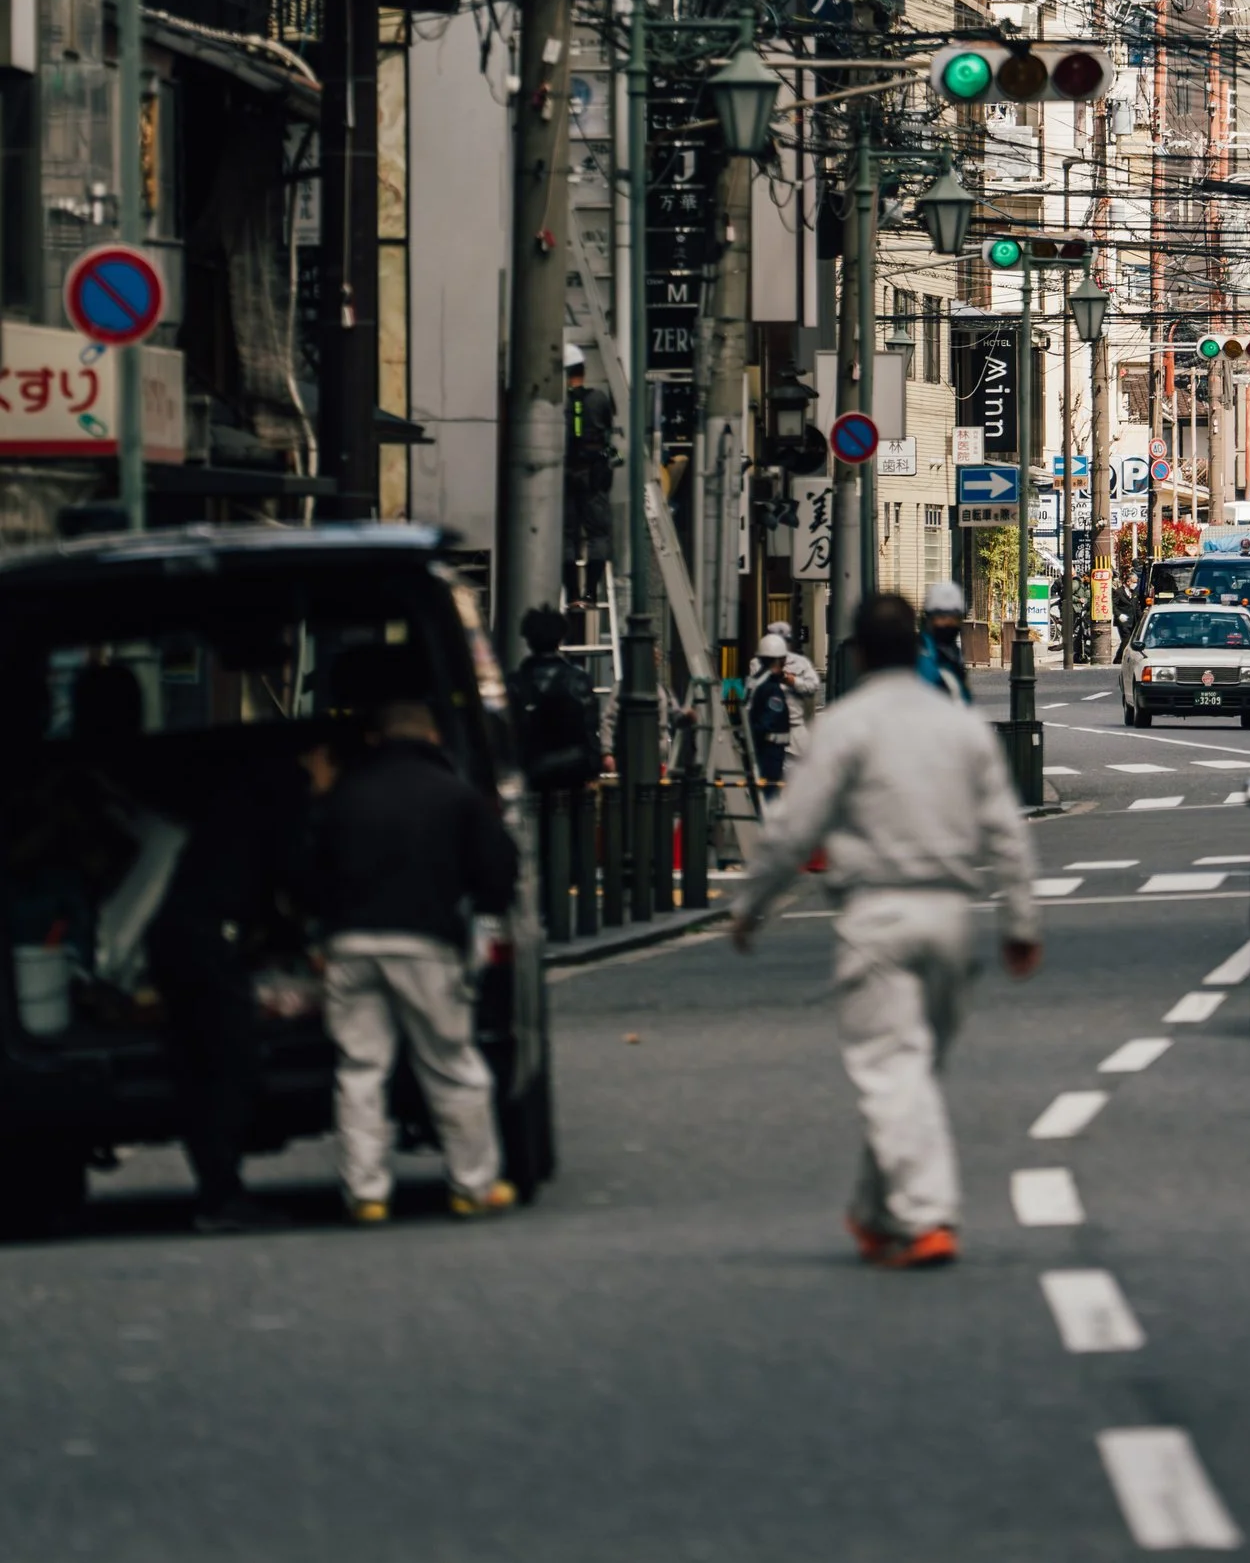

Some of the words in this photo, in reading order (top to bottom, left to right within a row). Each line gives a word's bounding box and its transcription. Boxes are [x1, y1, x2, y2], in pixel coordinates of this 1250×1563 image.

[667, 284, 688, 302] M
[983, 339, 1011, 347] HOTEL
[889, 439, 903, 455] 林
[957, 429, 971, 462] 林医院
[1153, 443, 1163, 454] 40
[882, 458, 910, 473] 歯科
[962, 508, 1017, 522] 自転車を除く
[1028, 606, 1047, 614] Mart
[1200, 696, 1221, 705] 32-09
